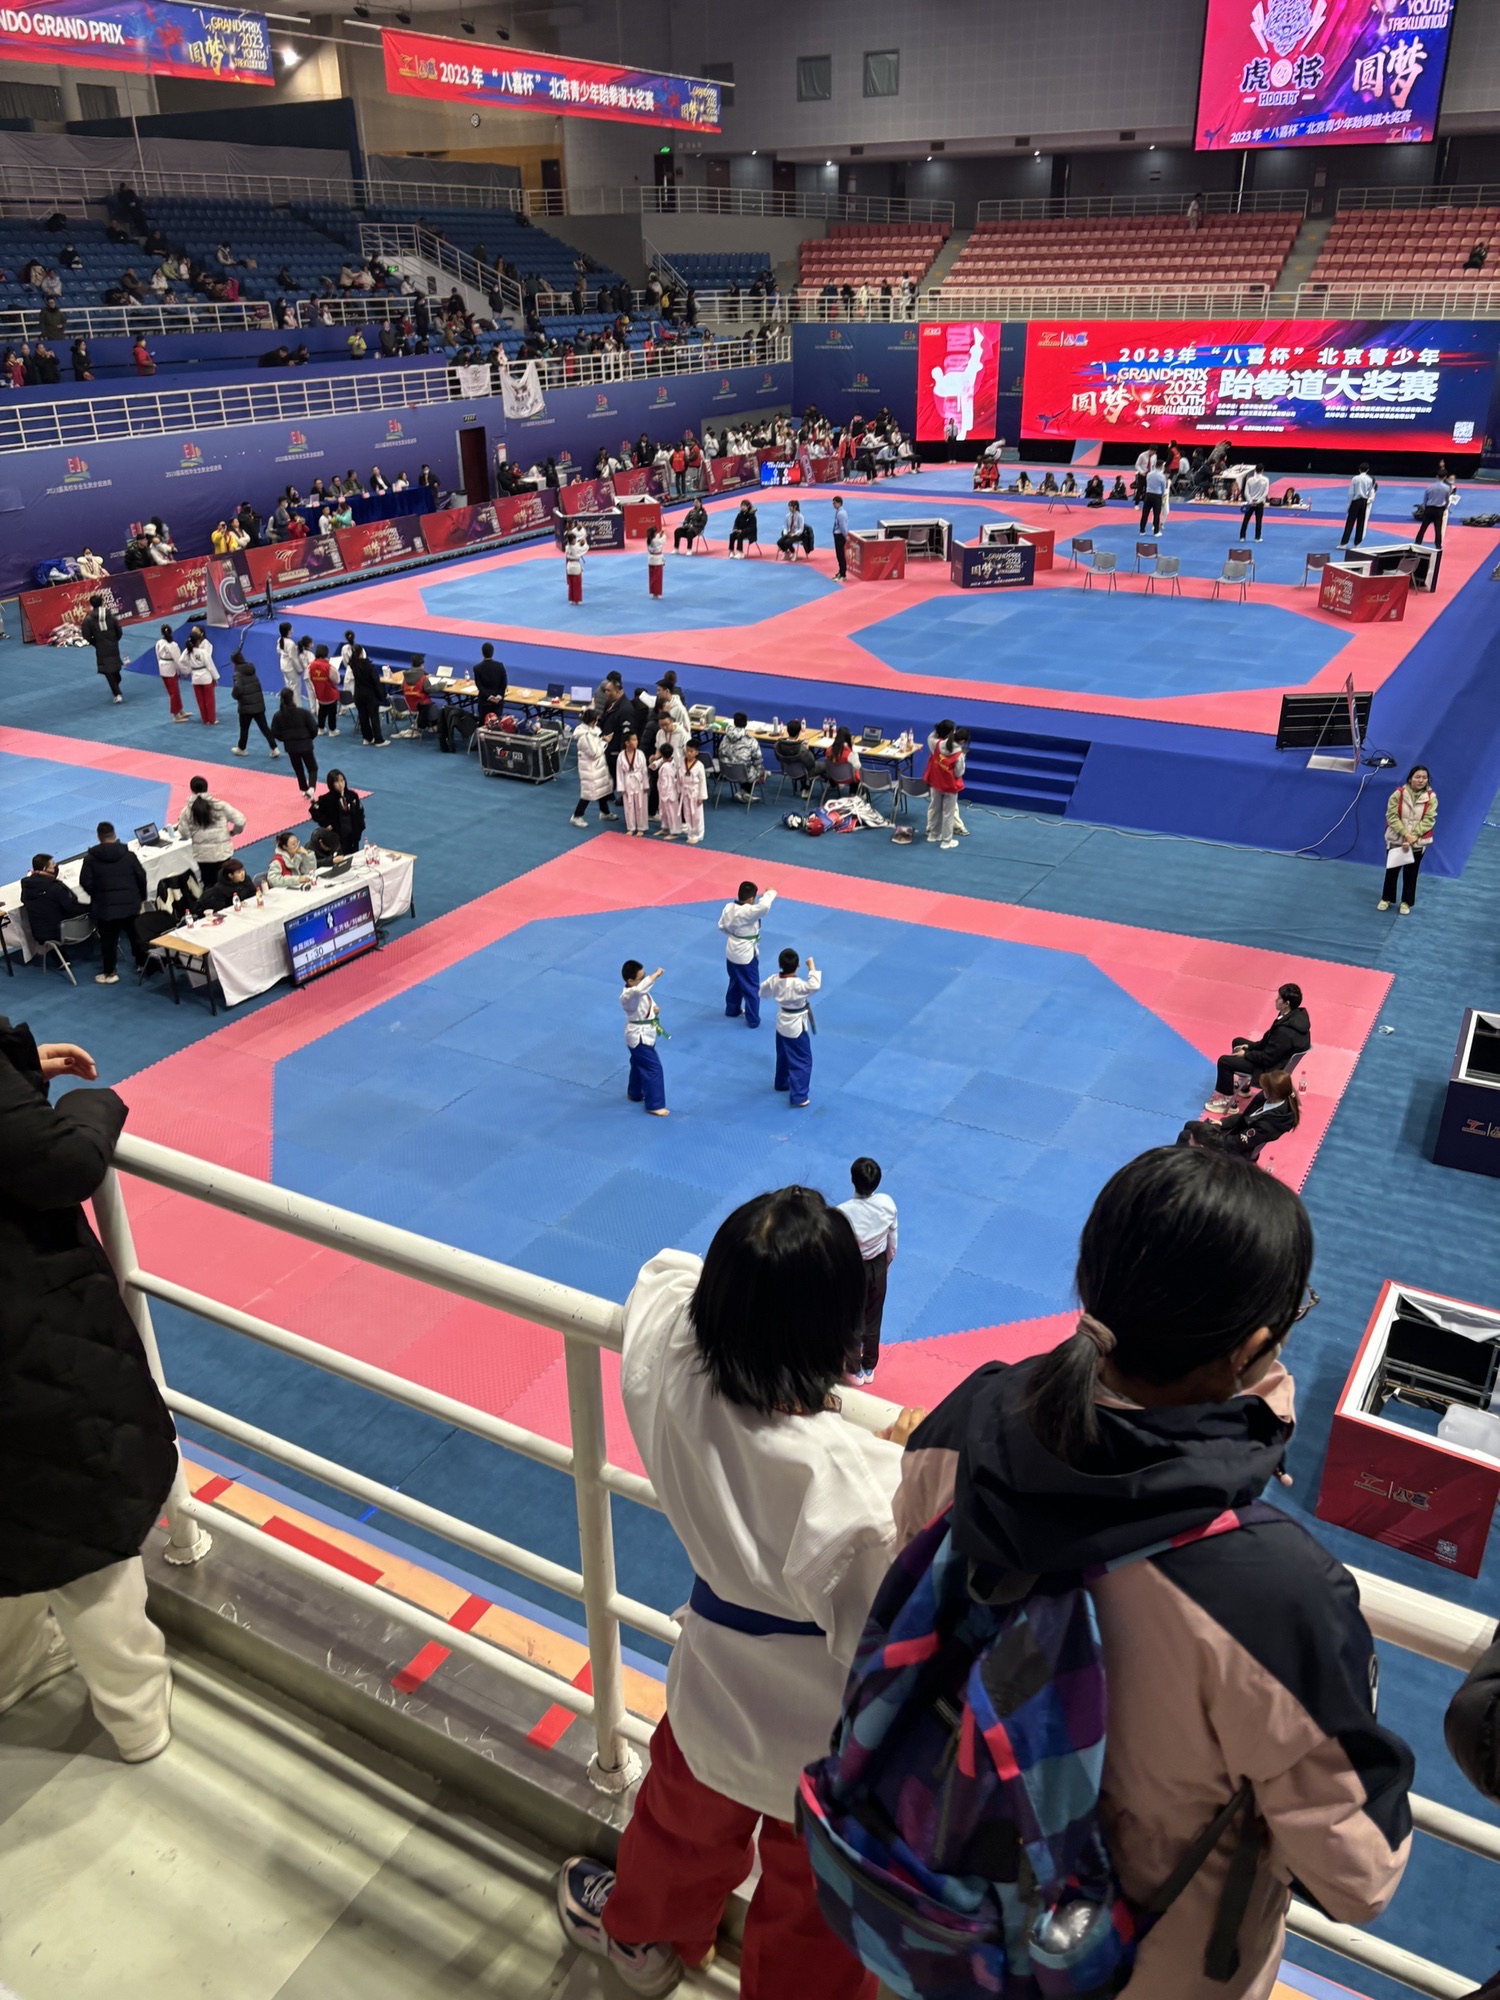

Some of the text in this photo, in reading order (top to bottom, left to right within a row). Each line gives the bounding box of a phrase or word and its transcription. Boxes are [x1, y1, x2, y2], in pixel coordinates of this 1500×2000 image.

[33, 13, 88, 40] GRAND
[88, 20, 125, 45] PRIX
[1352, 35, 1428, 110] 圆梦
[1258, 90, 1299, 107] HOOFIT
[1317, 347, 1440, 366] 北京青少年
[1117, 367, 1209, 381] GRAND PRIX
[1217, 368, 1440, 402] 跆拳道大奖赛
[1165, 380, 1207, 395] 2023
[1071, 382, 1133, 424] 圆梦
[219, 576, 246, 613] C
[304, 946, 324, 962] 1:30
